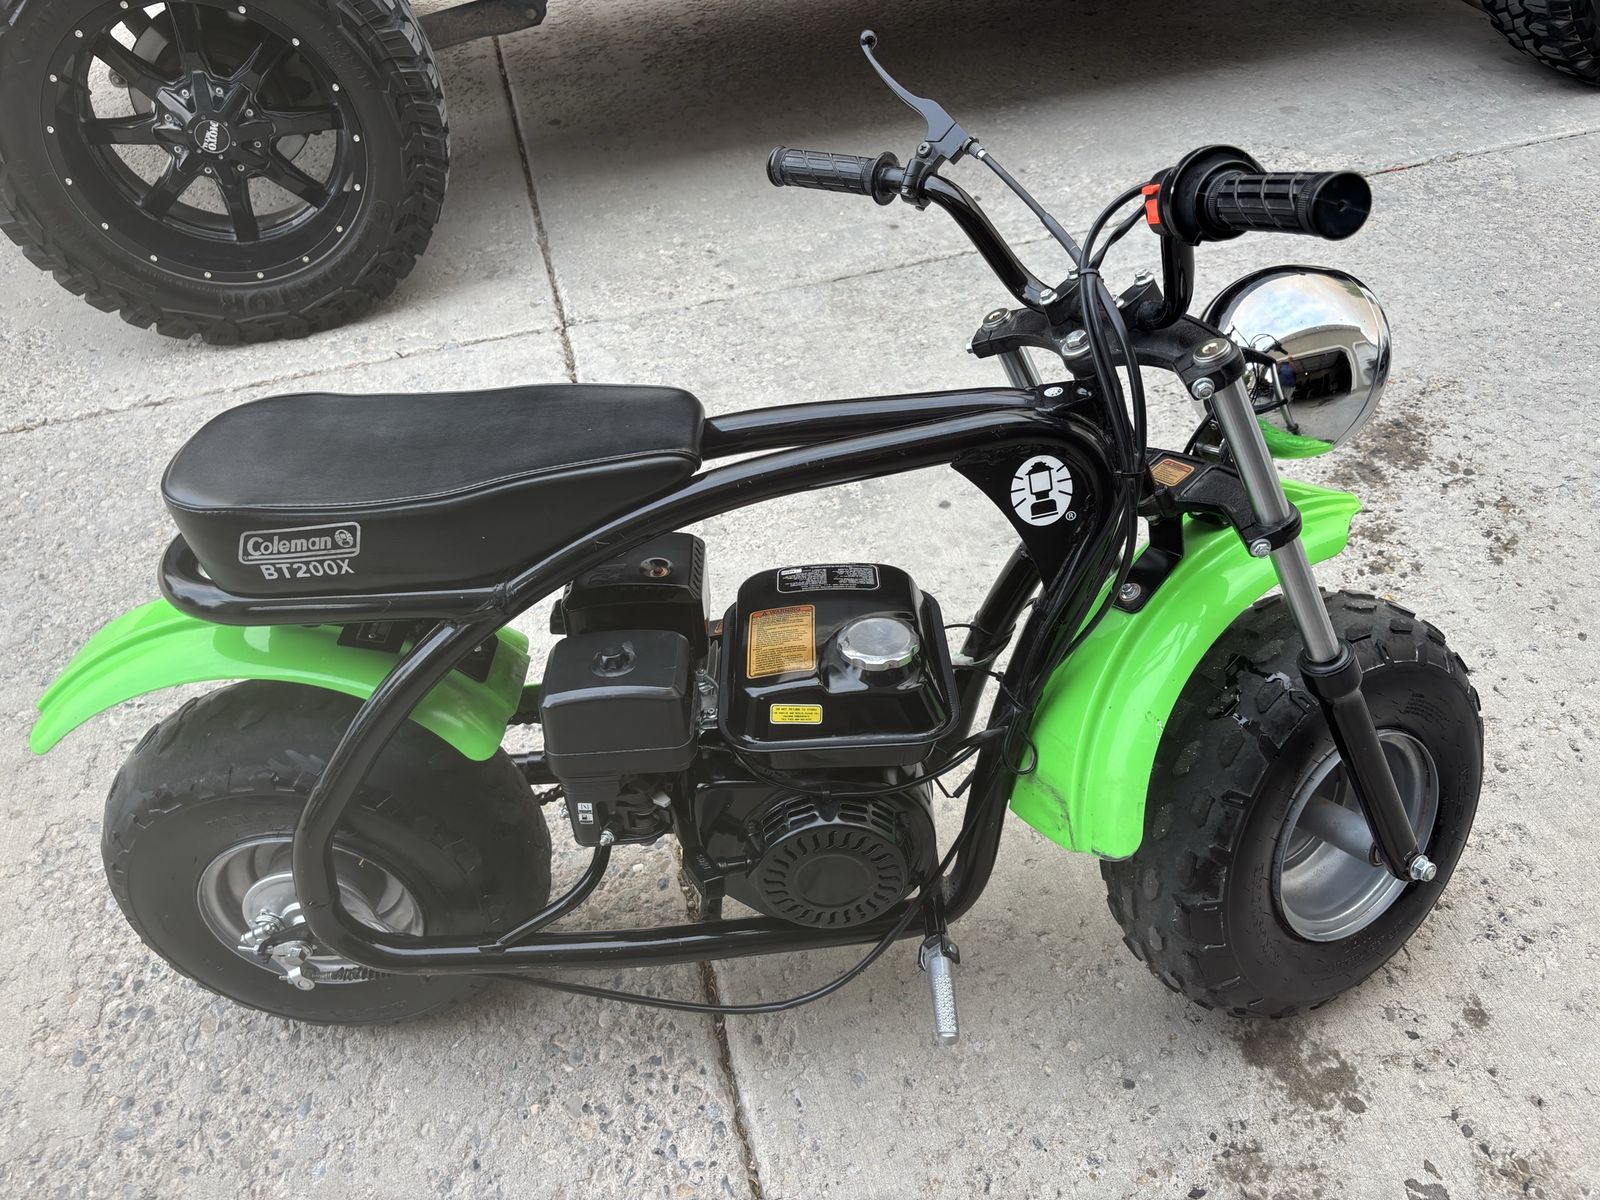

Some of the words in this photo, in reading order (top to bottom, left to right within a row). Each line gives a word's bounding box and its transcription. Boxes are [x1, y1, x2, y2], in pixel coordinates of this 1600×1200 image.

[208, 120, 219, 150] MOTO
[246, 535, 332, 556] Coleman
[259, 559, 356, 580] BT200X
